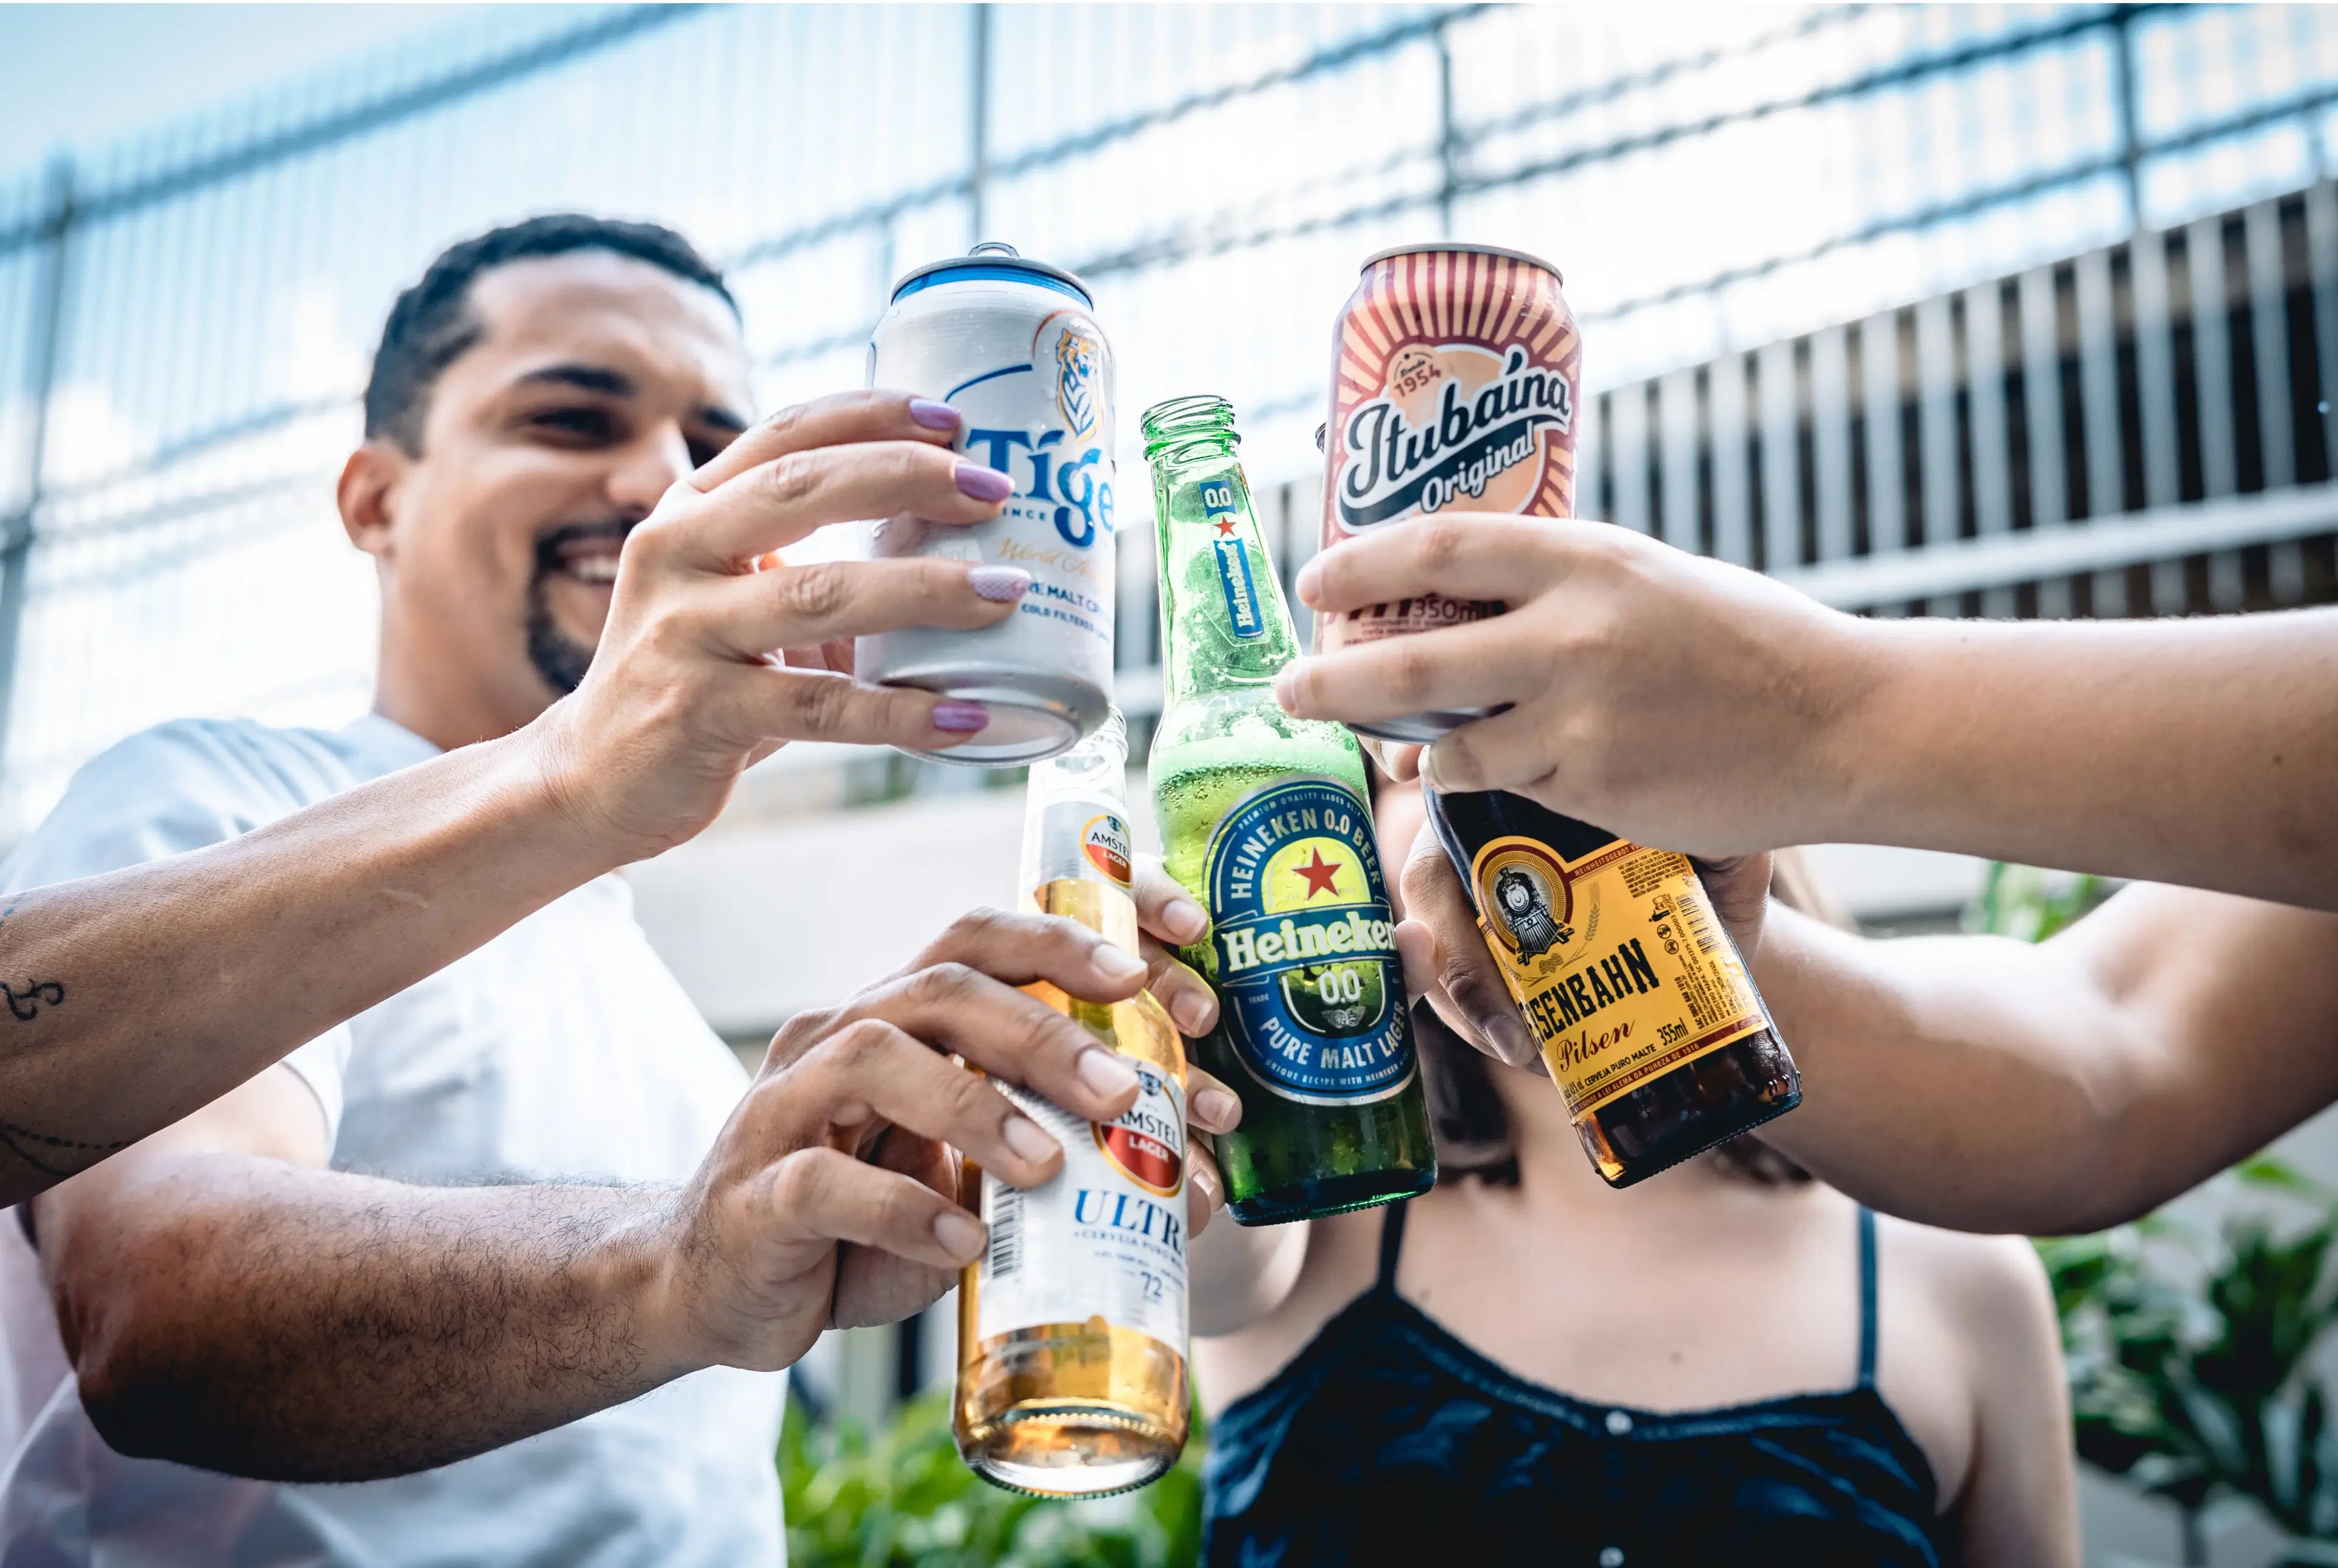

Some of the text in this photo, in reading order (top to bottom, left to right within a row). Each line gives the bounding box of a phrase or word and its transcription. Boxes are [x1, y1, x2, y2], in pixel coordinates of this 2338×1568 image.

[1394, 364, 1441, 397] 1954
[1347, 351, 1570, 499] Itubaína
[1422, 421, 1534, 512] Original
[966, 429, 1114, 547] Tige
[1205, 488, 1232, 508] 0.0
[1003, 506, 1047, 521] INCE
[1047, 586, 1084, 606] MALT
[1217, 542, 1254, 628] Heineken
[1022, 603, 1050, 617] COLD
[1238, 801, 1277, 830] PREMIUM
[1280, 793, 1318, 804] QUALITY
[1321, 793, 1344, 805] LAGER
[1091, 831, 1131, 861] AMSTEL
[1103, 851, 1127, 869] LAGER
[1230, 808, 1381, 899] HEINEKEN 0.0 BEER
[1574, 847, 1629, 877] REINHEITSGEBOT
[1319, 969, 1361, 1005] 0.0
[1699, 972, 1711, 991] MAPA:
[1674, 976, 1705, 1030] SAC 0800 888 1010
[1708, 991, 1725, 1019] REGISTRO
[1260, 1001, 1405, 1069] PURE MALT LAGER
[1557, 1019, 1635, 1072] Pilsen
[1657, 1017, 1689, 1046] 355ml
[1265, 1059, 1399, 1086] UNIQUE RECIPE WITH HEINEKEN
[1584, 1068, 1610, 1087] CERVEJA
[1610, 1057, 1631, 1072] PURO
[1631, 1043, 1656, 1062] MALTE
[1603, 1087, 1611, 1097] LEI
[1634, 1071, 1643, 1080] DA
[1644, 1058, 1671, 1074] PUREZA
[1672, 1051, 1680, 1060] DE
[1682, 1044, 1699, 1055] 1516
[1129, 1135, 1169, 1163] LAGER
[1074, 1189, 1186, 1257] ULTR
[1140, 1270, 1162, 1298] 72
